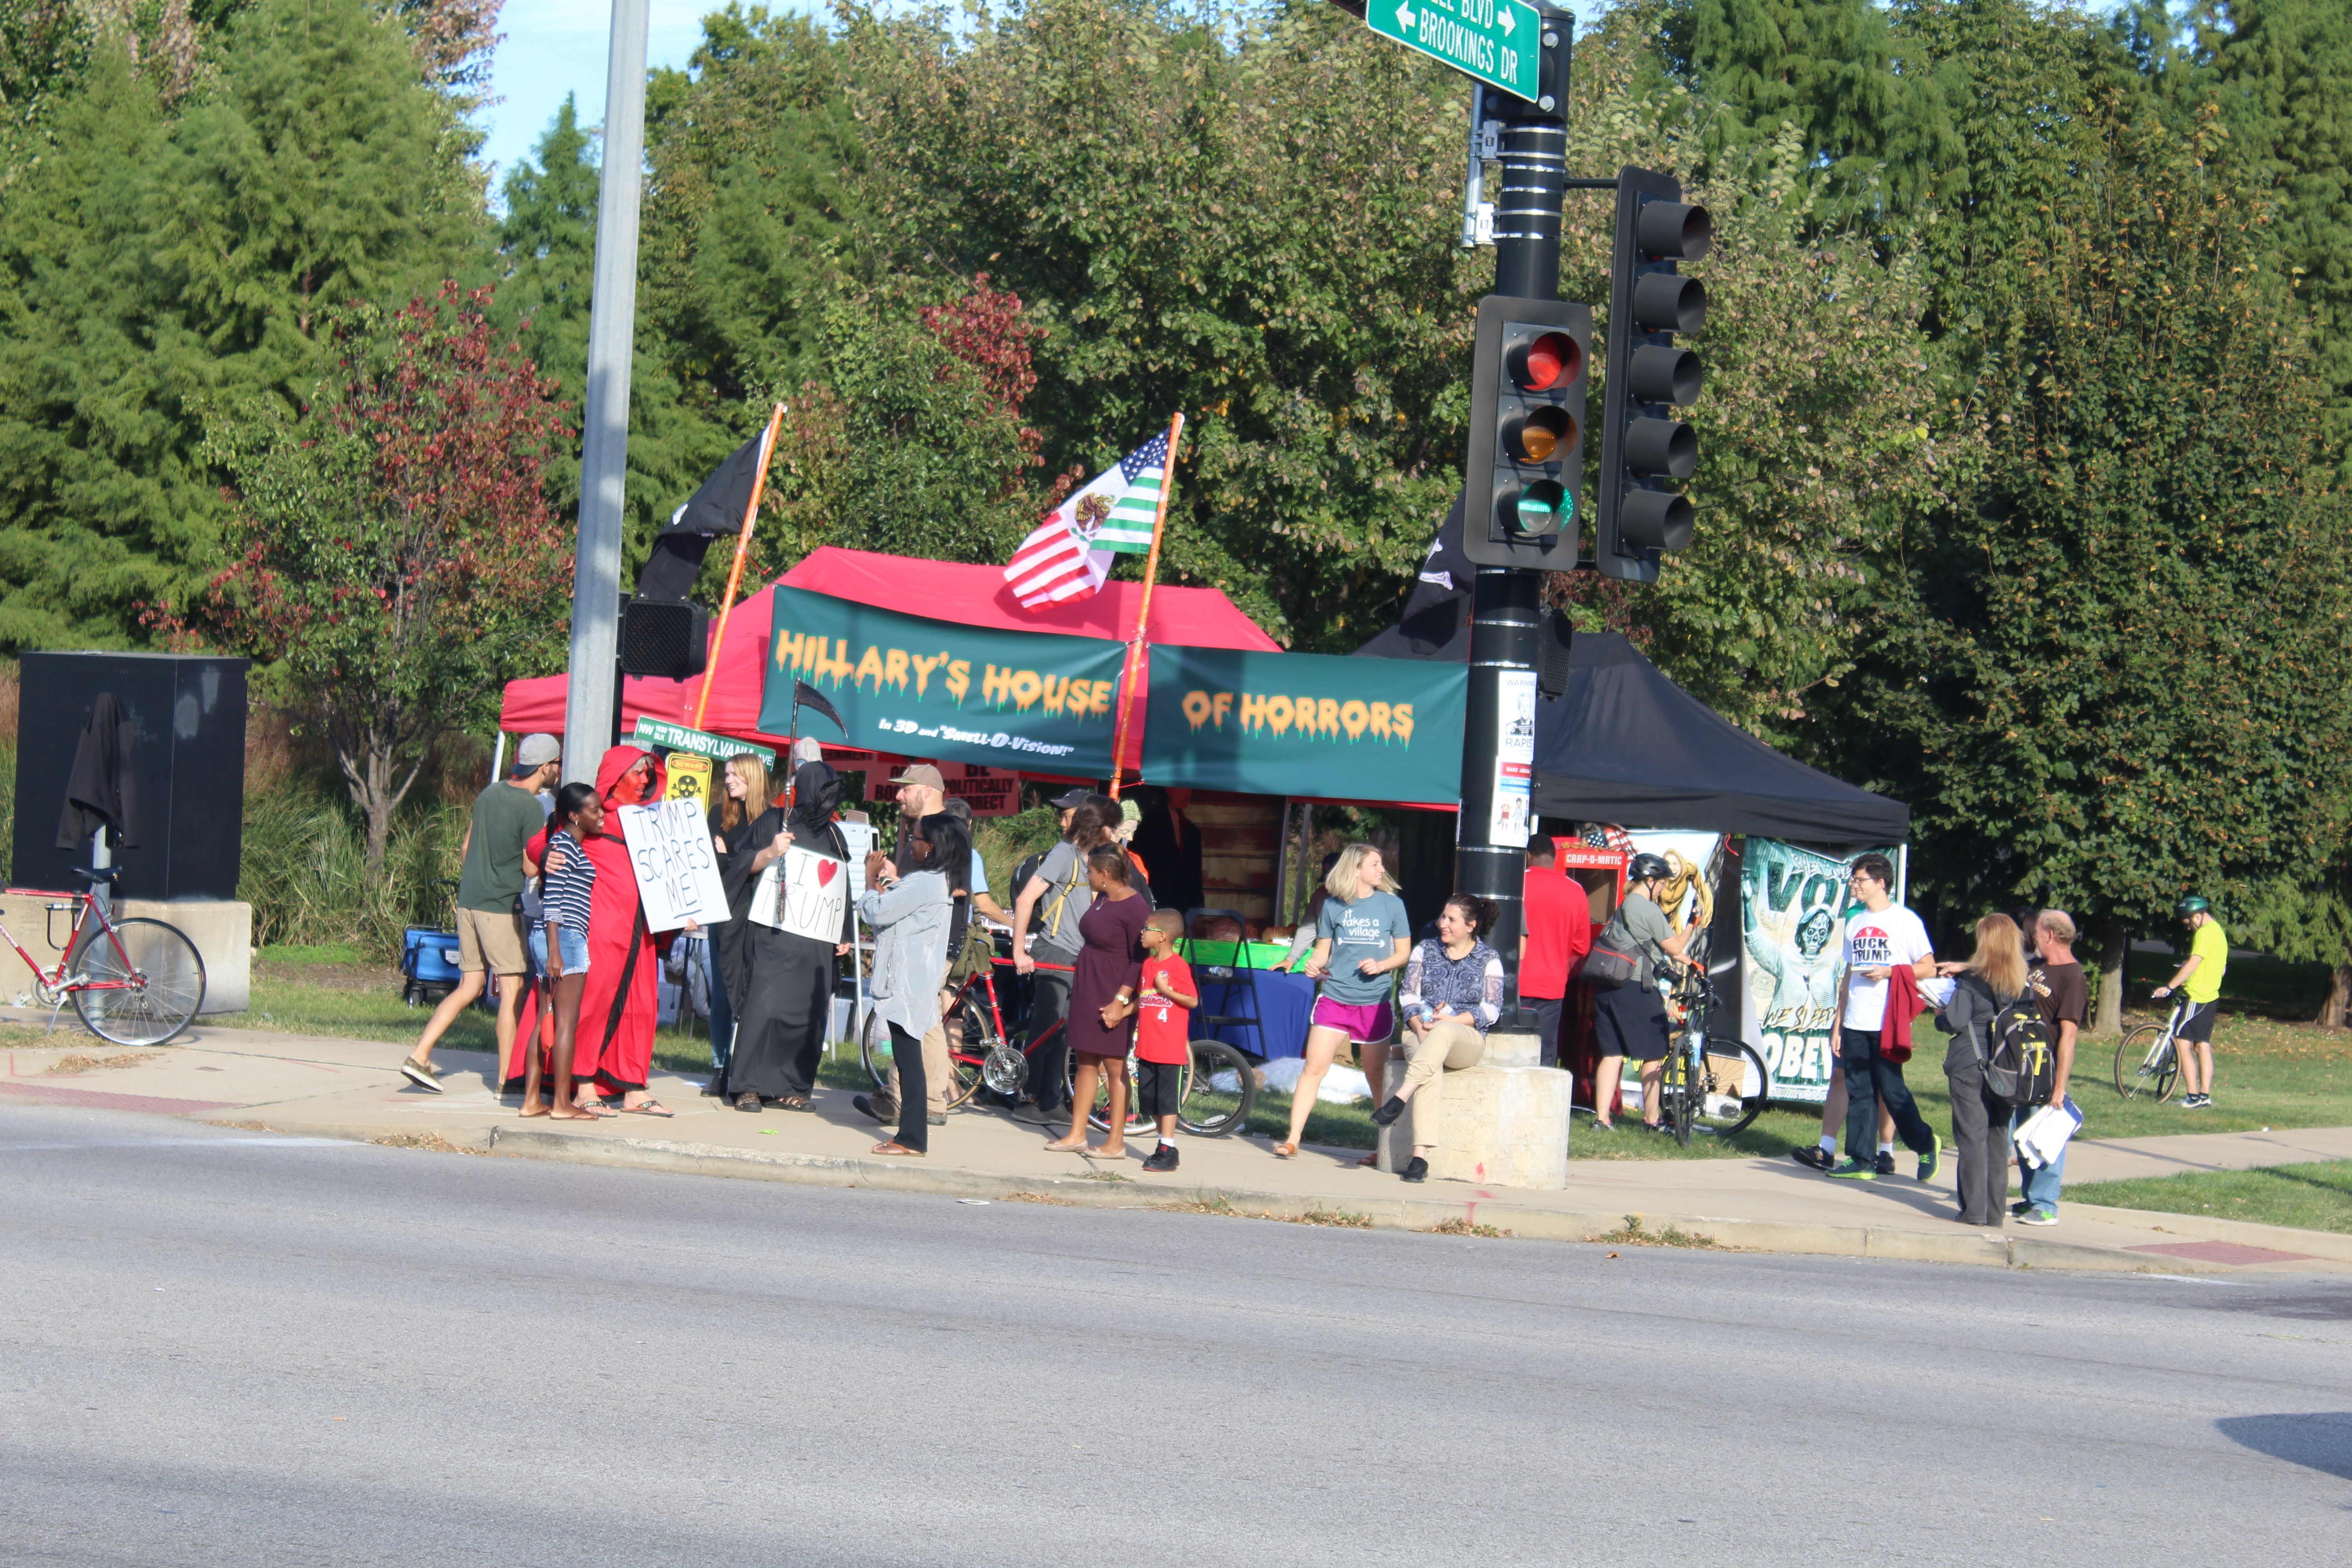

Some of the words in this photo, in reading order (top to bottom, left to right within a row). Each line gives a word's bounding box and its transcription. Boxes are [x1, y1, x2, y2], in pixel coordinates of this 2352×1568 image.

[1461, 0, 1494, 29] BLVD
[1419, 7, 1494, 74] BROOKINGS
[1501, 46, 1518, 84] DR
[776, 629, 971, 710] HILLARY'S
[982, 664, 1113, 727] HOUSE
[893, 720, 918, 734] 3D
[918, 726, 939, 738] and
[1182, 690, 1234, 736] OF
[1240, 693, 1414, 751] HORRORS
[638, 723, 654, 735] NW
[656, 725, 667, 734] 1600
[668, 728, 754, 760] TRANSYLVANIA
[758, 755, 774, 766] AVE
[654, 732, 666, 741] BLK
[675, 760, 704, 770] BEWARE
[943, 778, 1015, 794] POLITICALLY
[961, 795, 1006, 811] RRECT
[632, 801, 696, 843] TRUMP
[637, 837, 710, 882] SCARES
[1566, 853, 1622, 865] CRAP-O-MATIC
[794, 853, 813, 887] I
[665, 873, 703, 912] ME!
[1768, 860, 1851, 919] VOT
[761, 878, 843, 938] TRUMP
[1345, 908, 1352, 919] it
[1342, 917, 1371, 927] takes
[1349, 926, 1380, 941] village
[1853, 938, 1888, 951] FUCK
[1852, 949, 1891, 962] TRUMP
[1158, 1008, 1167, 1023] 4
[1762, 1007, 1793, 1029] WE
